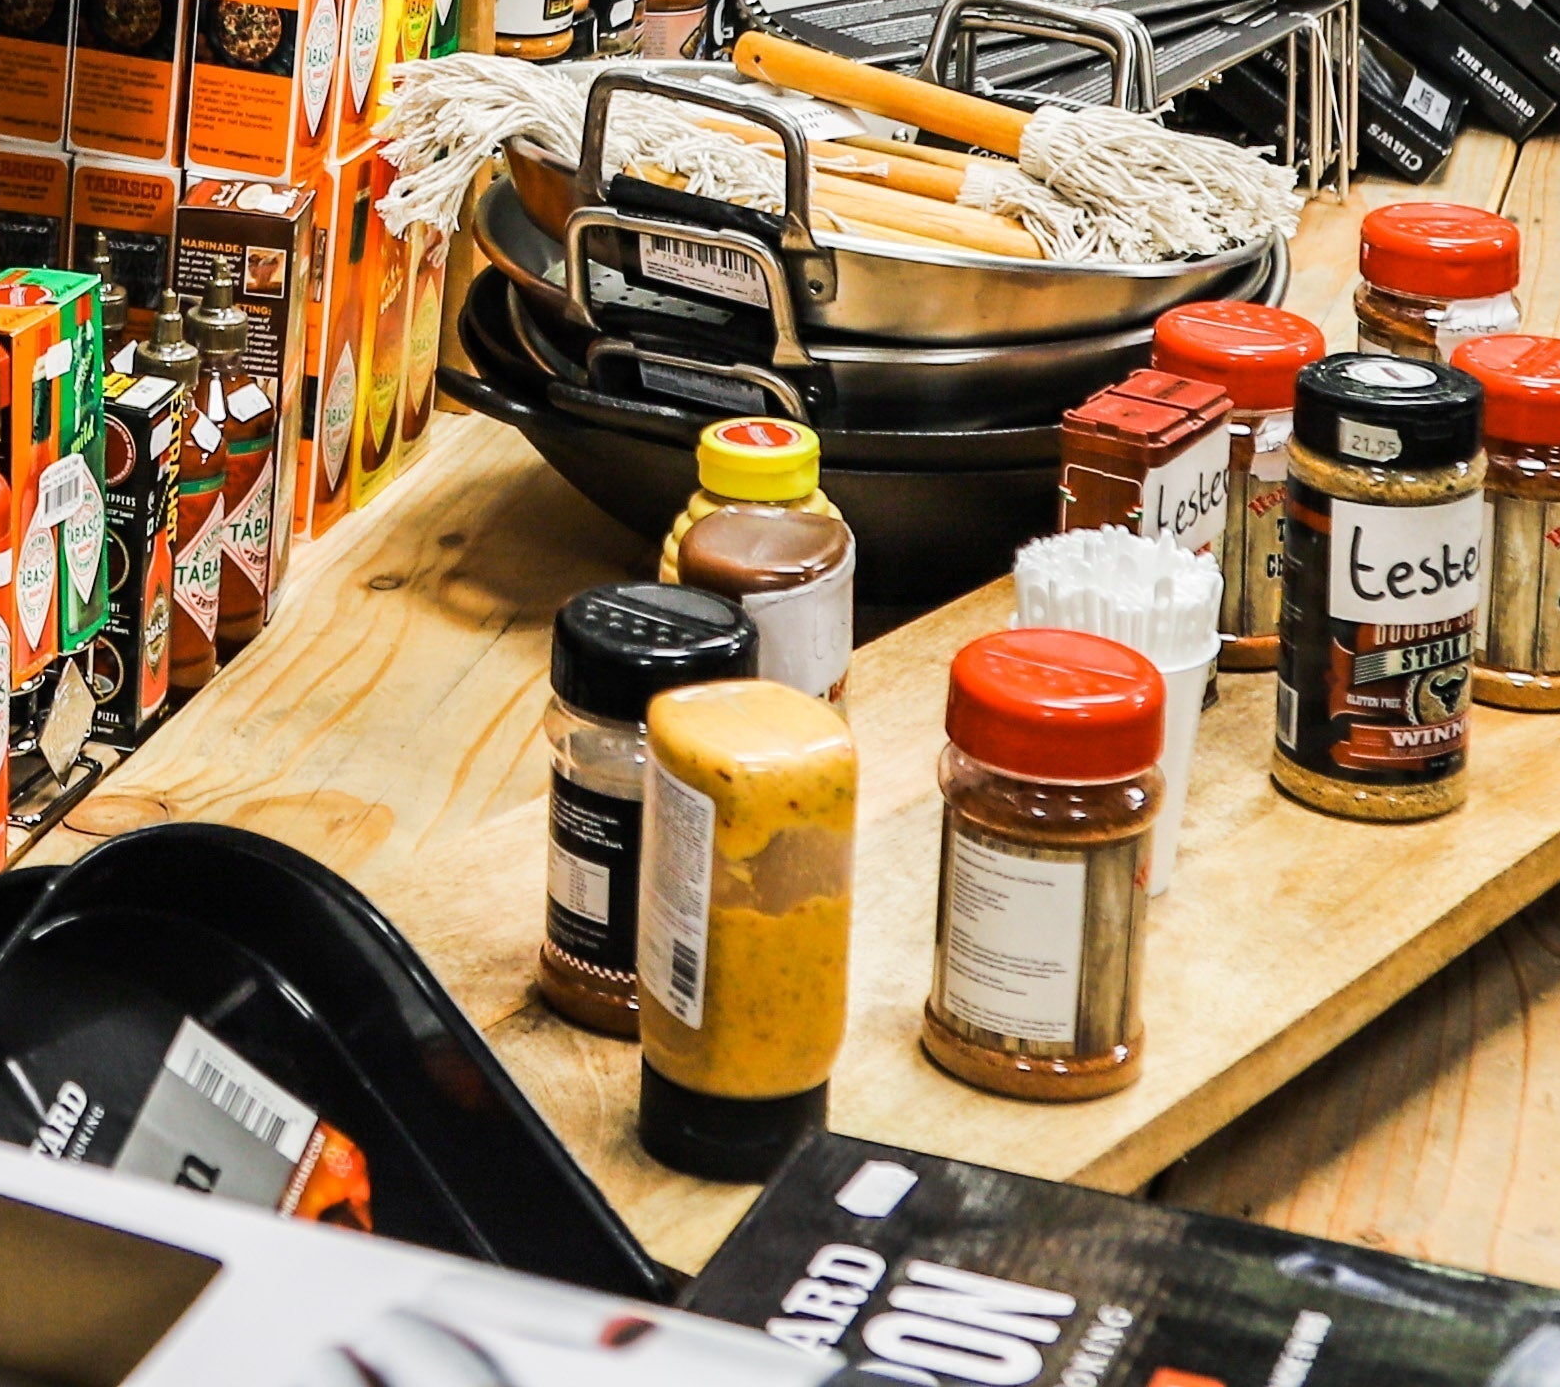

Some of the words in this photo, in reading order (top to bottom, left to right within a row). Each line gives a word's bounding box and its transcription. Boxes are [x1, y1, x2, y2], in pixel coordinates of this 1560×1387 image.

[1455, 45, 1484, 75] THE
[1482, 66, 1537, 120] BASTARD
[83, 175, 163, 200] TABASCO
